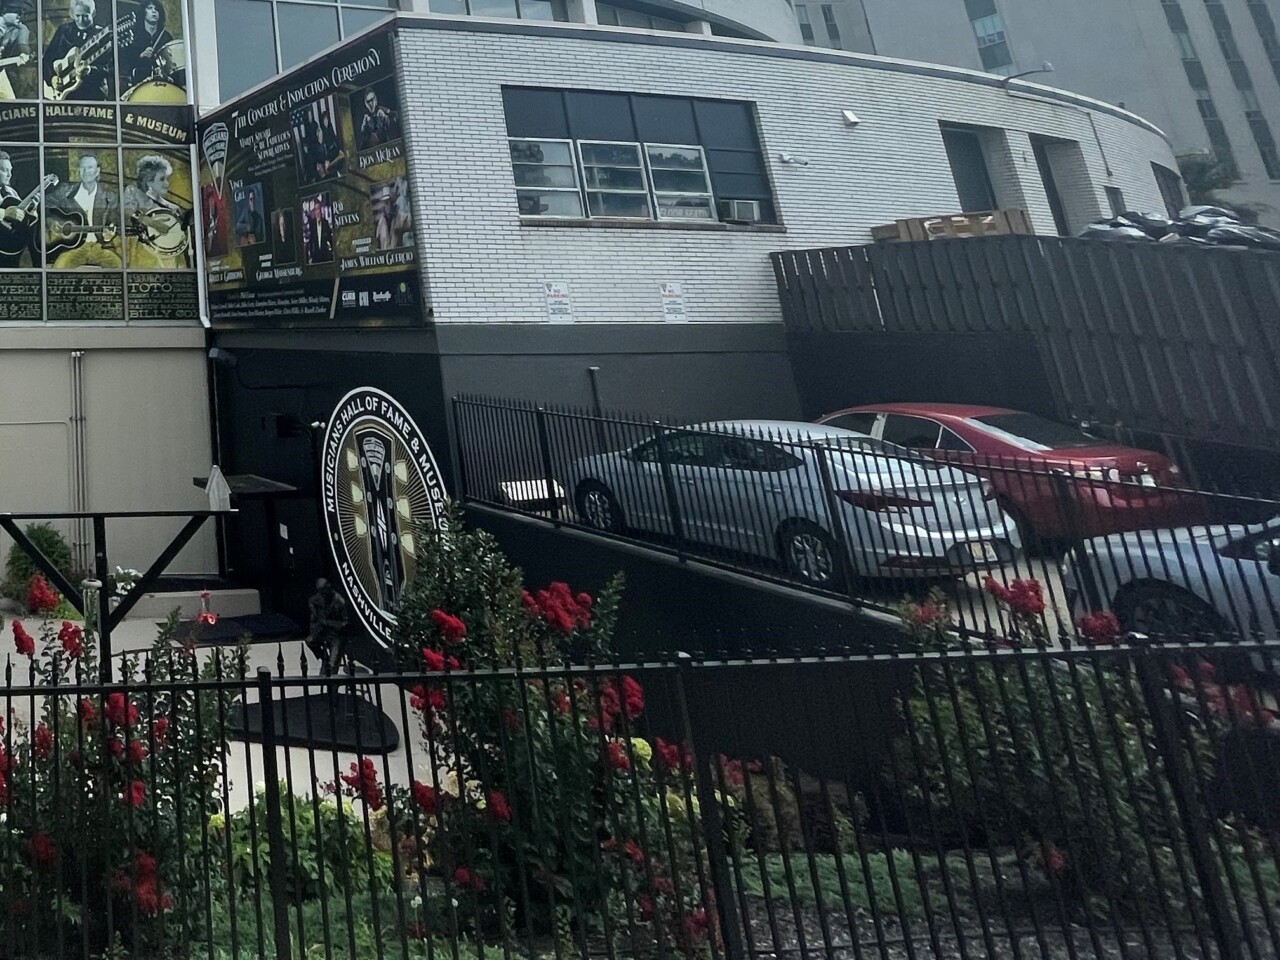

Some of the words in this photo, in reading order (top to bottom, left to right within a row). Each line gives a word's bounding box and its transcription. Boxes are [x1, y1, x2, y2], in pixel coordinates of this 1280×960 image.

[231, 111, 247, 138] 7TH
[249, 100, 279, 127] CONCERT
[280, 94, 287, 111] &
[287, 77, 330, 108] INDUCTION
[331, 48, 381, 87] CEREMONY
[45, 106, 74, 117] HALL
[83, 106, 114, 119] FAME
[125, 113, 134, 125] &
[136, 115, 187, 141] MUSEUM
[359, 155, 374, 170] DON
[334, 212, 360, 228] STEVENS
[340, 258, 358, 272] JAMES
[359, 254, 385, 268] WILLIAM
[385, 251, 414, 266] GUERCIO
[48, 286, 90, 294] WILL
[92, 286, 122, 294] LEE
[127, 283, 173, 293] TOTO
[10, 303, 18, 311] &
[19, 303, 41, 311] THE
[129, 310, 172, 318] BILLY
[325, 421, 344, 513] MUSICIANS
[340, 398, 365, 423] HALL
[365, 395, 379, 411] OF
[381, 401, 411, 440] FAME
[410, 437, 420, 454] &
